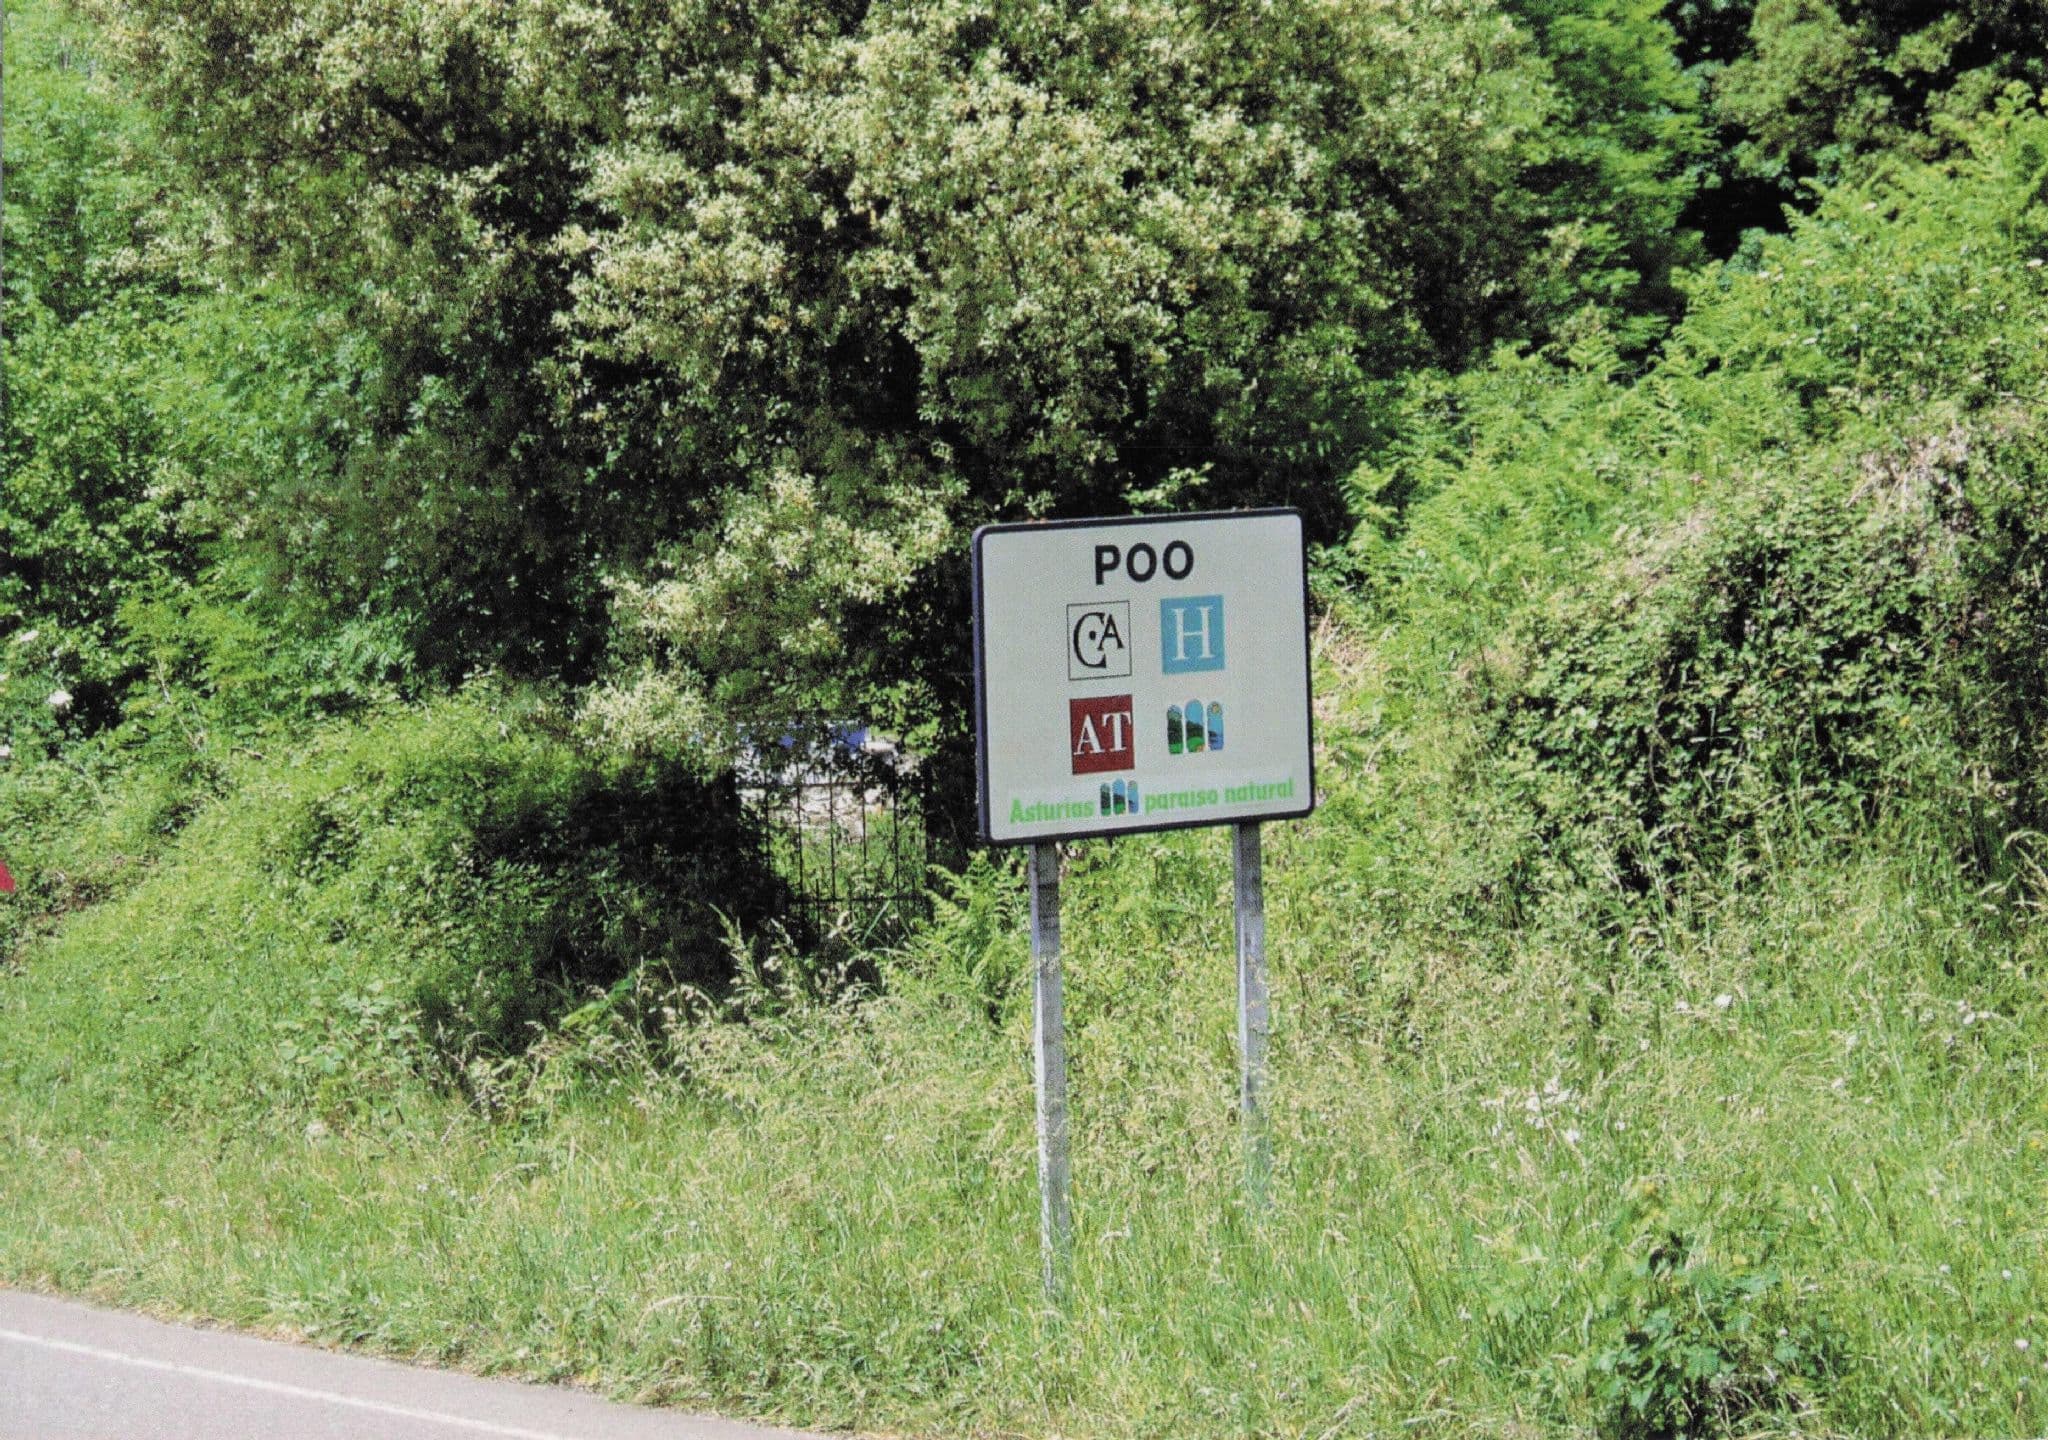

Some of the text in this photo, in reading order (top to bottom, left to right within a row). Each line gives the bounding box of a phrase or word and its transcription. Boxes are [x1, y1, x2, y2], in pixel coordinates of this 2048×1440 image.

[1094, 540, 1194, 586] POO
[1171, 604, 1215, 662] H
[1073, 712, 1132, 756] AT
[1009, 798, 1095, 824] Asturias
[1225, 778, 1295, 804] natural
